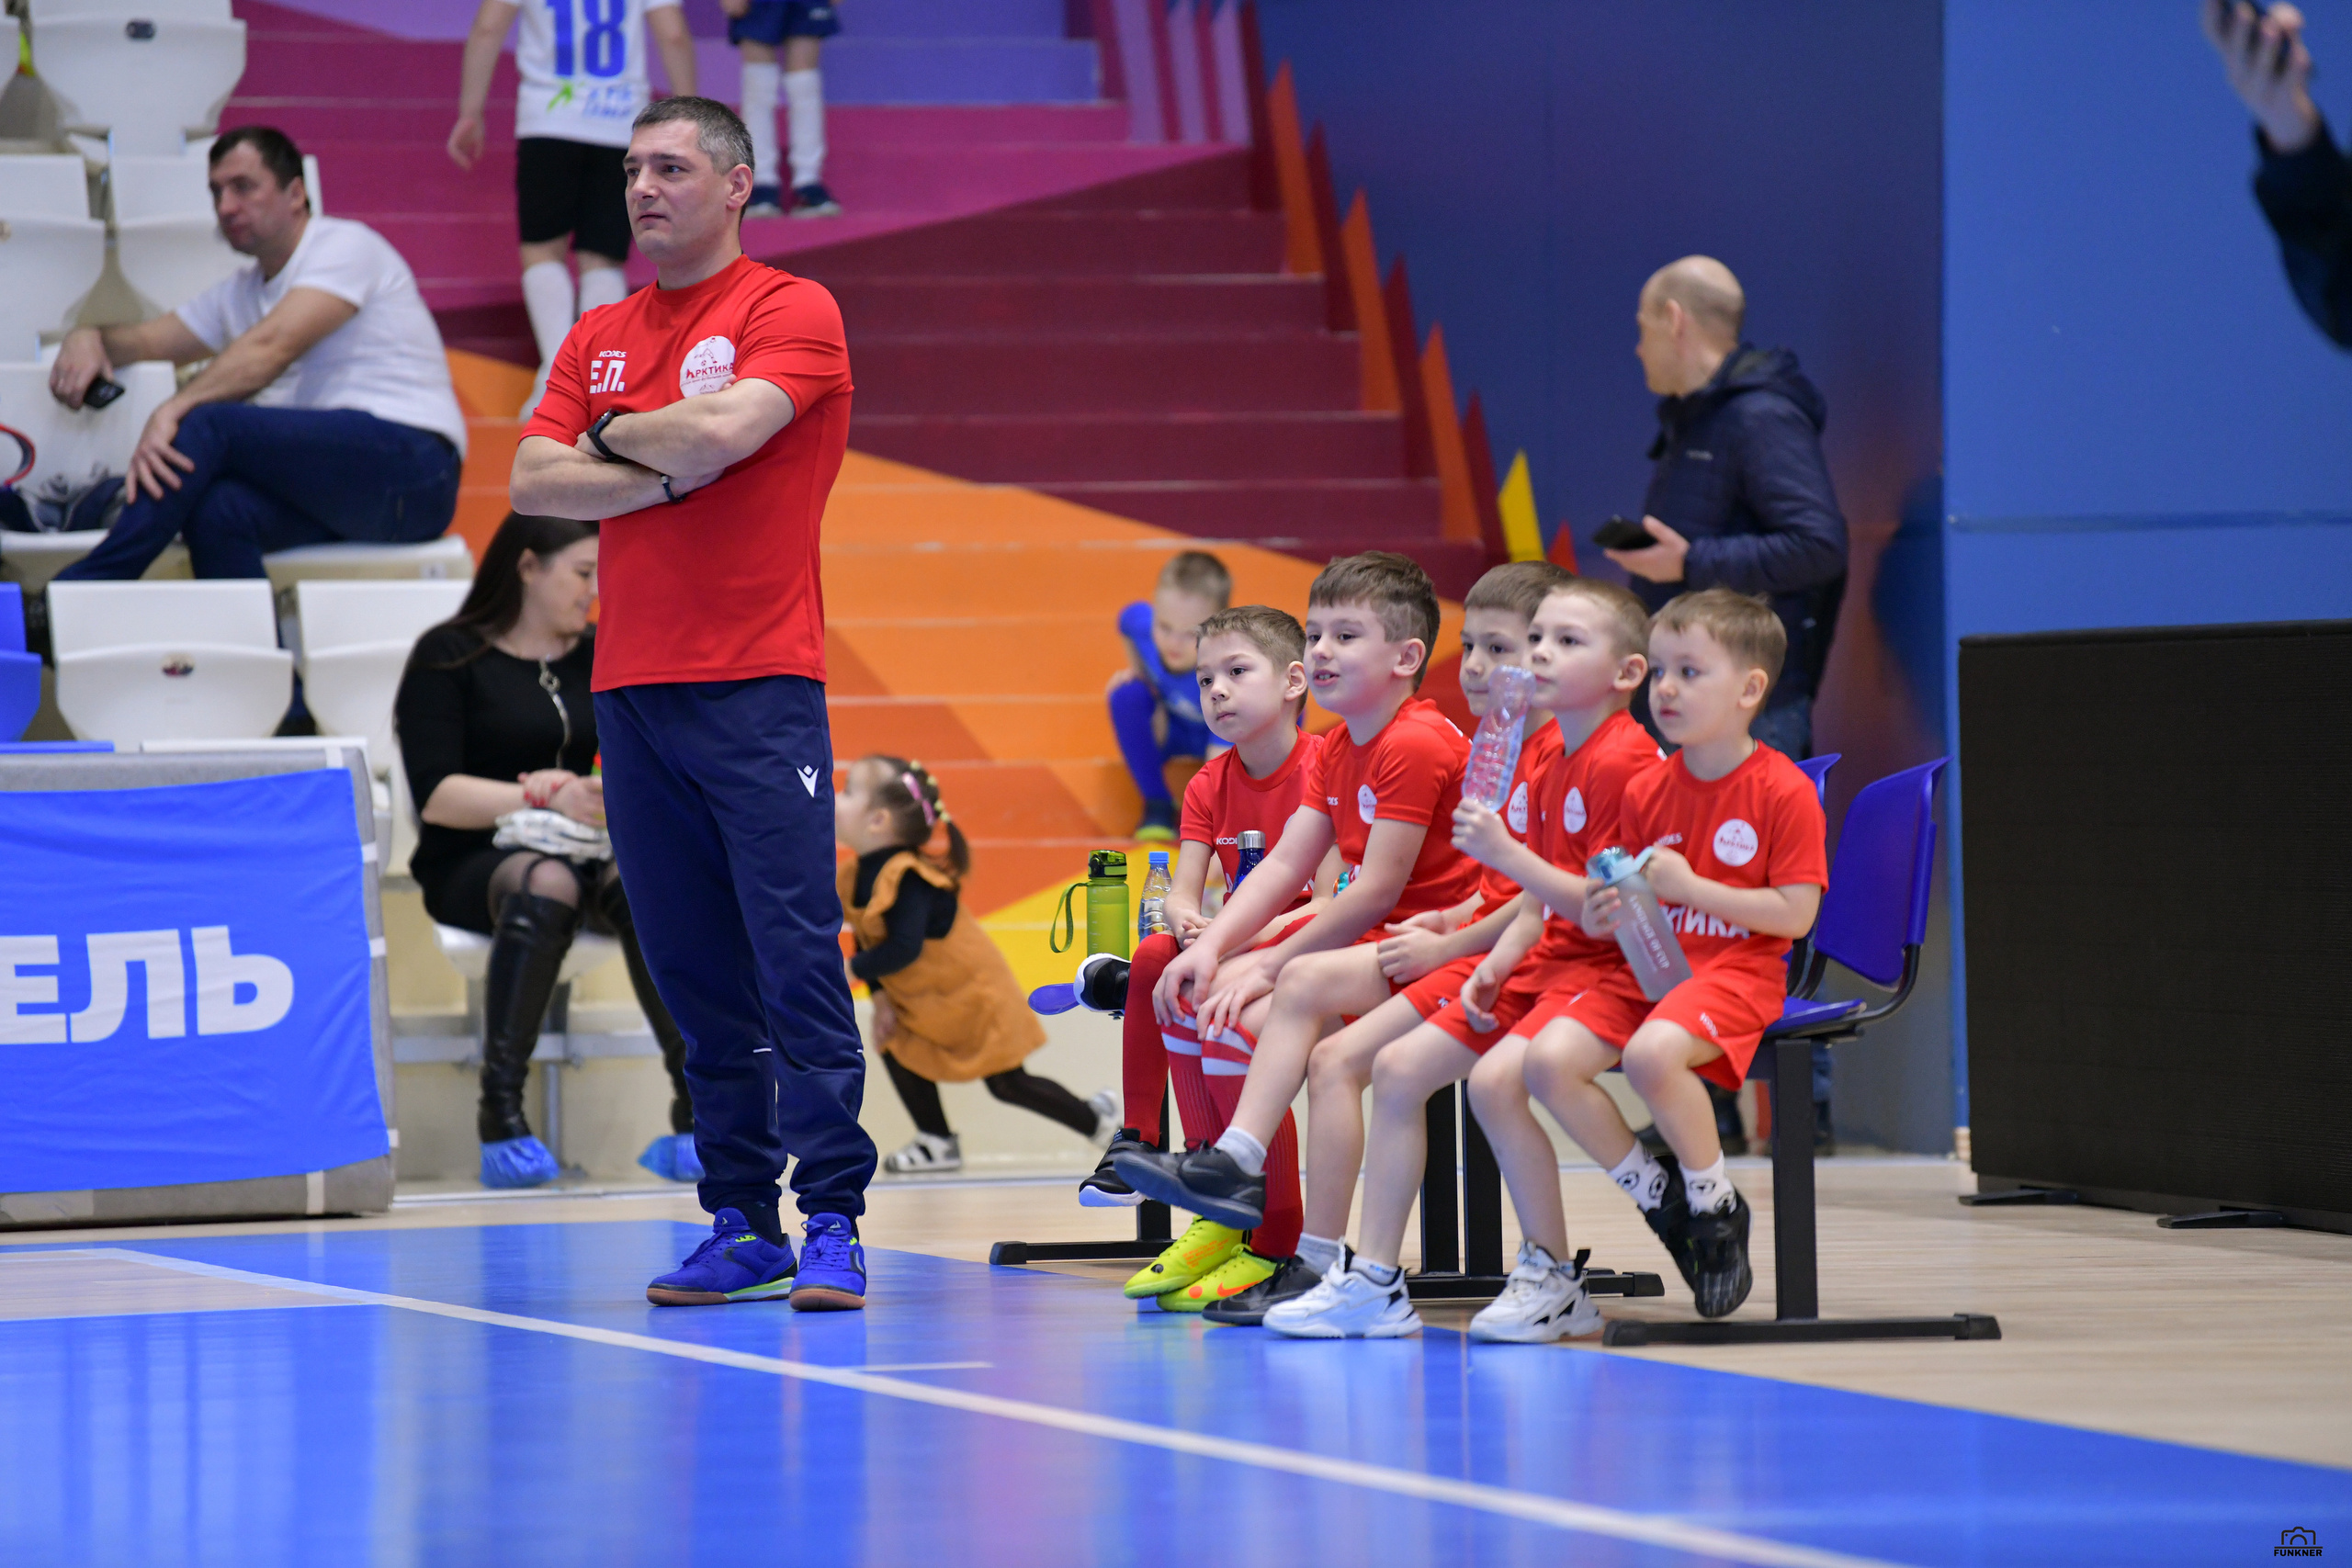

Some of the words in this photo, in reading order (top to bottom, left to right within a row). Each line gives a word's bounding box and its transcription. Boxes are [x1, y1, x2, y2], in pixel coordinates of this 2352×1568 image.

[546, 0, 626, 77] 18
[685, 362, 734, 379] АРКТИКА
[0, 925, 294, 1044] ЕЛЬ
